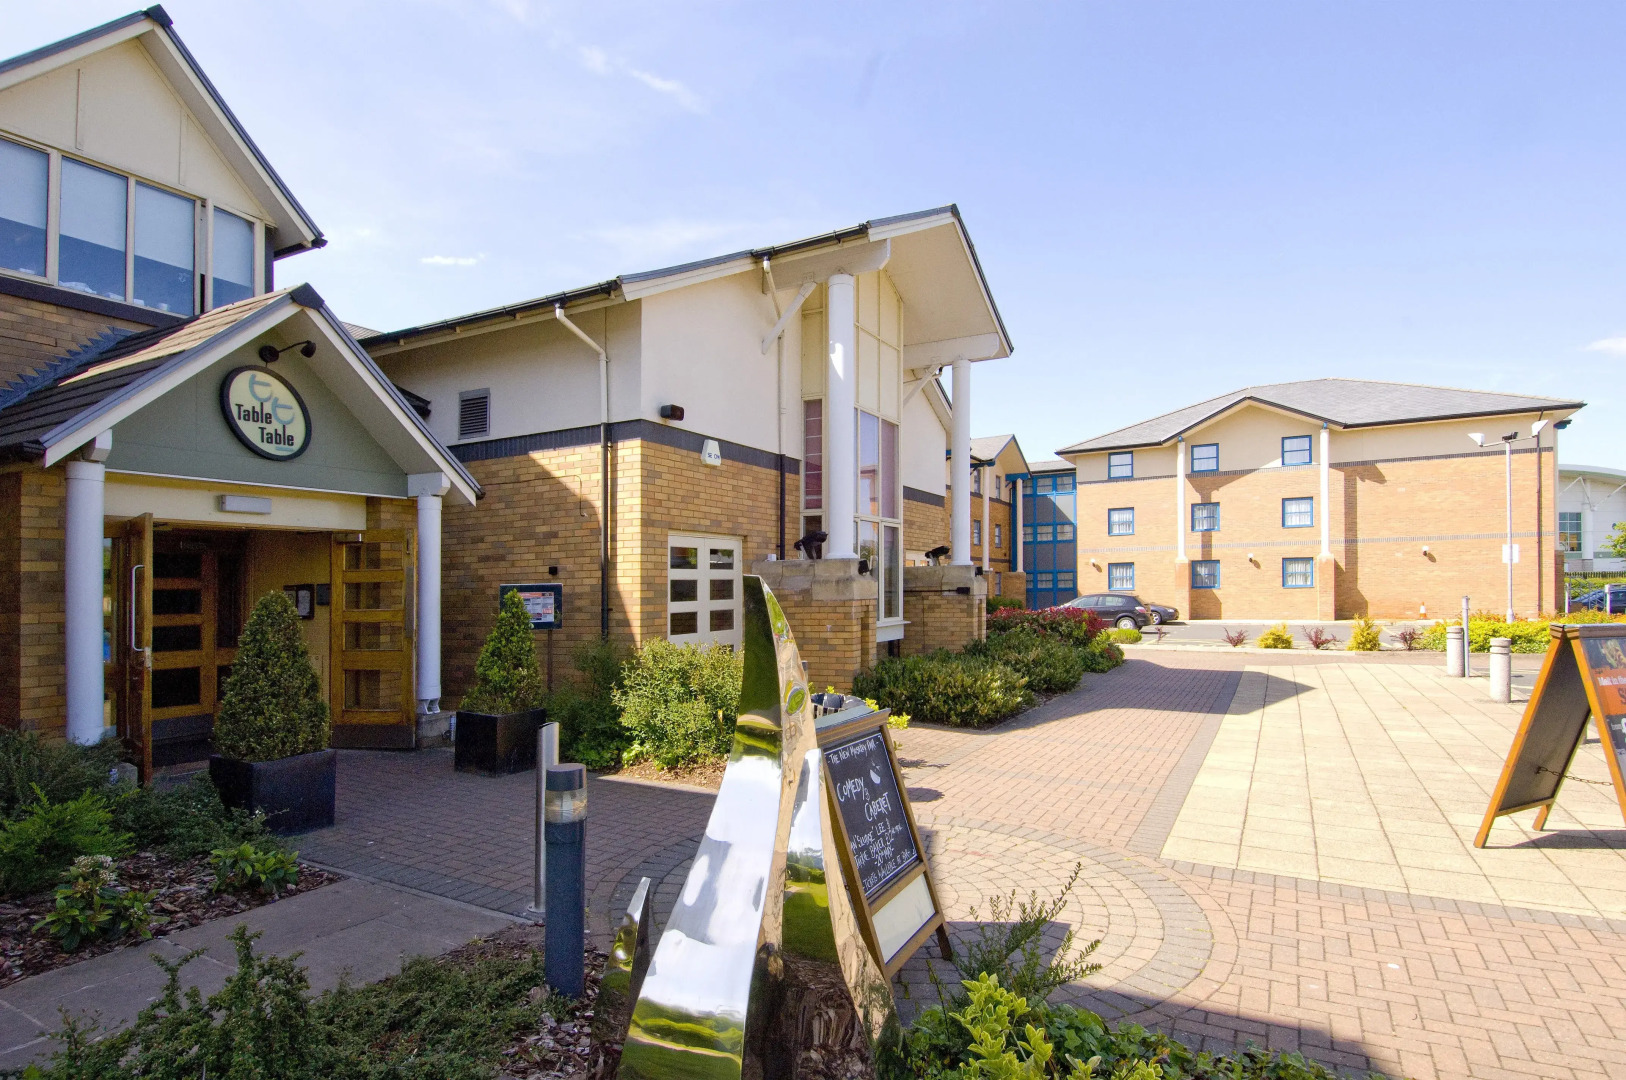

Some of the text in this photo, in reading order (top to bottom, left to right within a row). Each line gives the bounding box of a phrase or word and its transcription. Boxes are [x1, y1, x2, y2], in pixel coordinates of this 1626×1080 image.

[235, 402, 273, 424] Table
[258, 424, 295, 446] Table
[836, 776, 865, 802] COMEDY
[864, 791, 892, 821] CABERET
